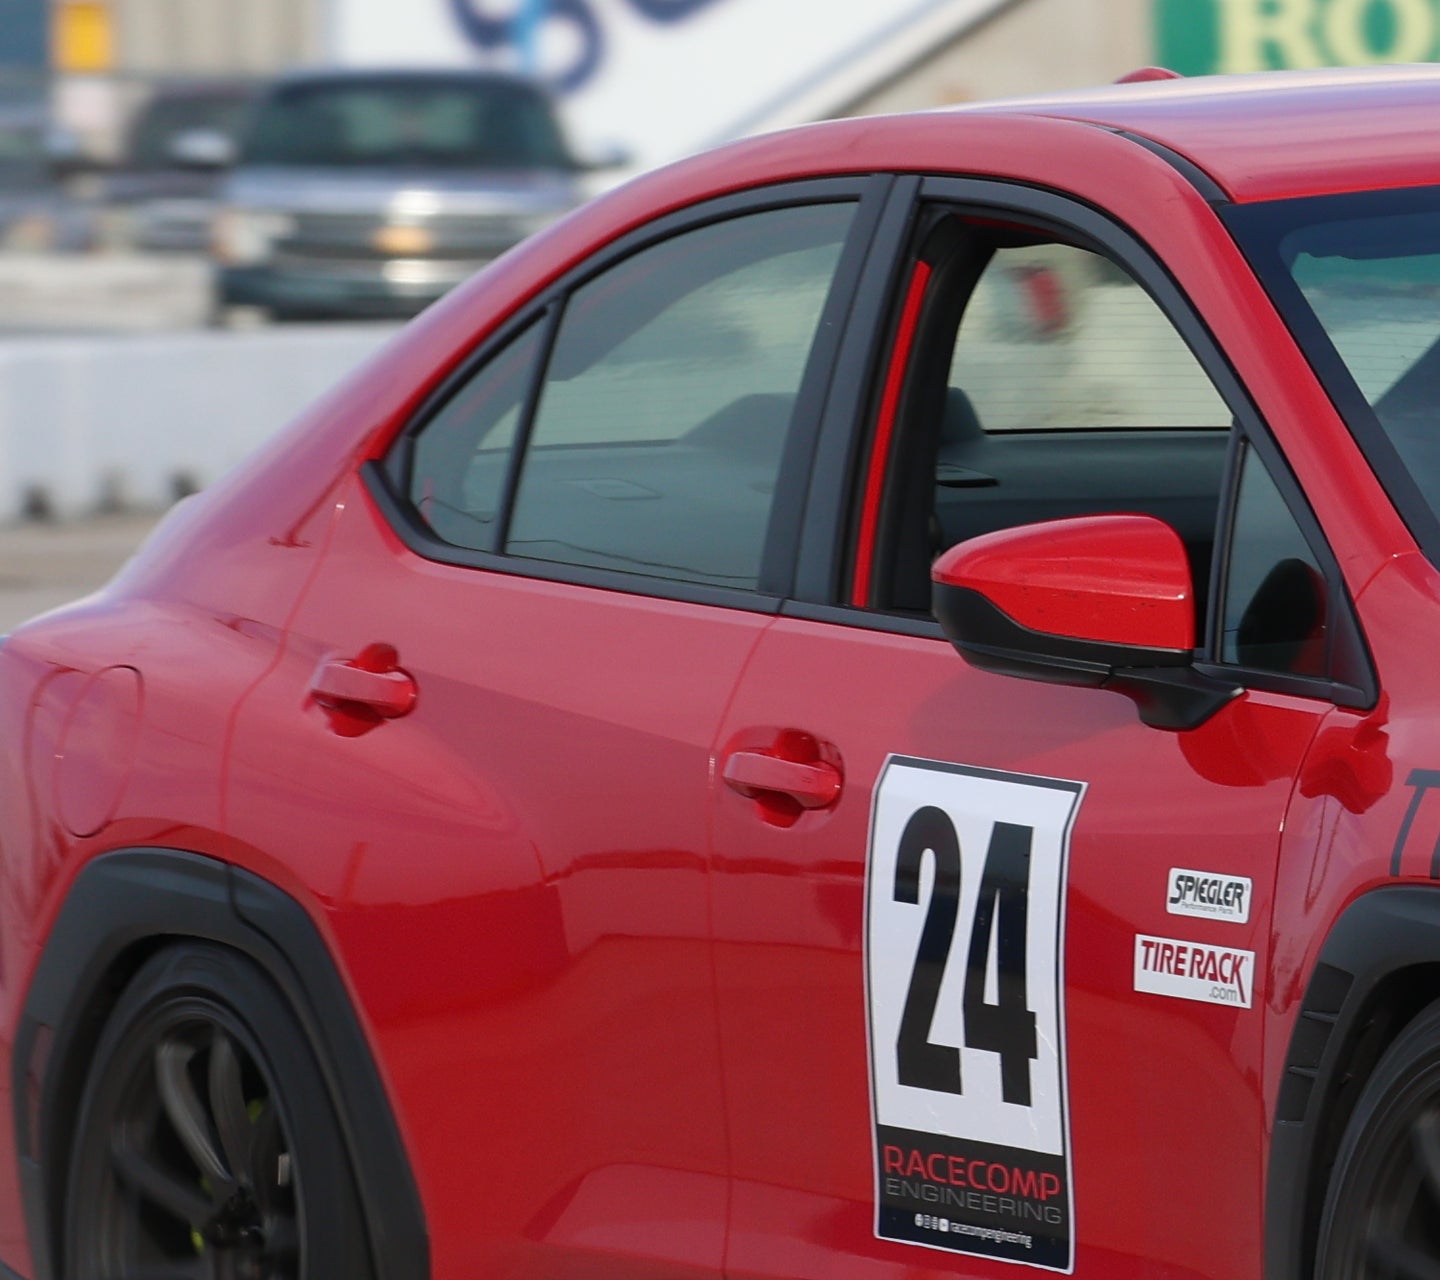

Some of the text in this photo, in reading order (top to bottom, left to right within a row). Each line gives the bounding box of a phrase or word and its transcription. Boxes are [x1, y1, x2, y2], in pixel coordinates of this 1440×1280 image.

[1169, 875, 1244, 913] SPIEGLER
[893, 805, 1038, 1107] 24
[1141, 940, 1246, 1004] TIRE RACK
[1209, 987, 1238, 1003] .com
[883, 1145, 1060, 1201] RACECOMP
[886, 1177, 1062, 1224] ENGINEERING
